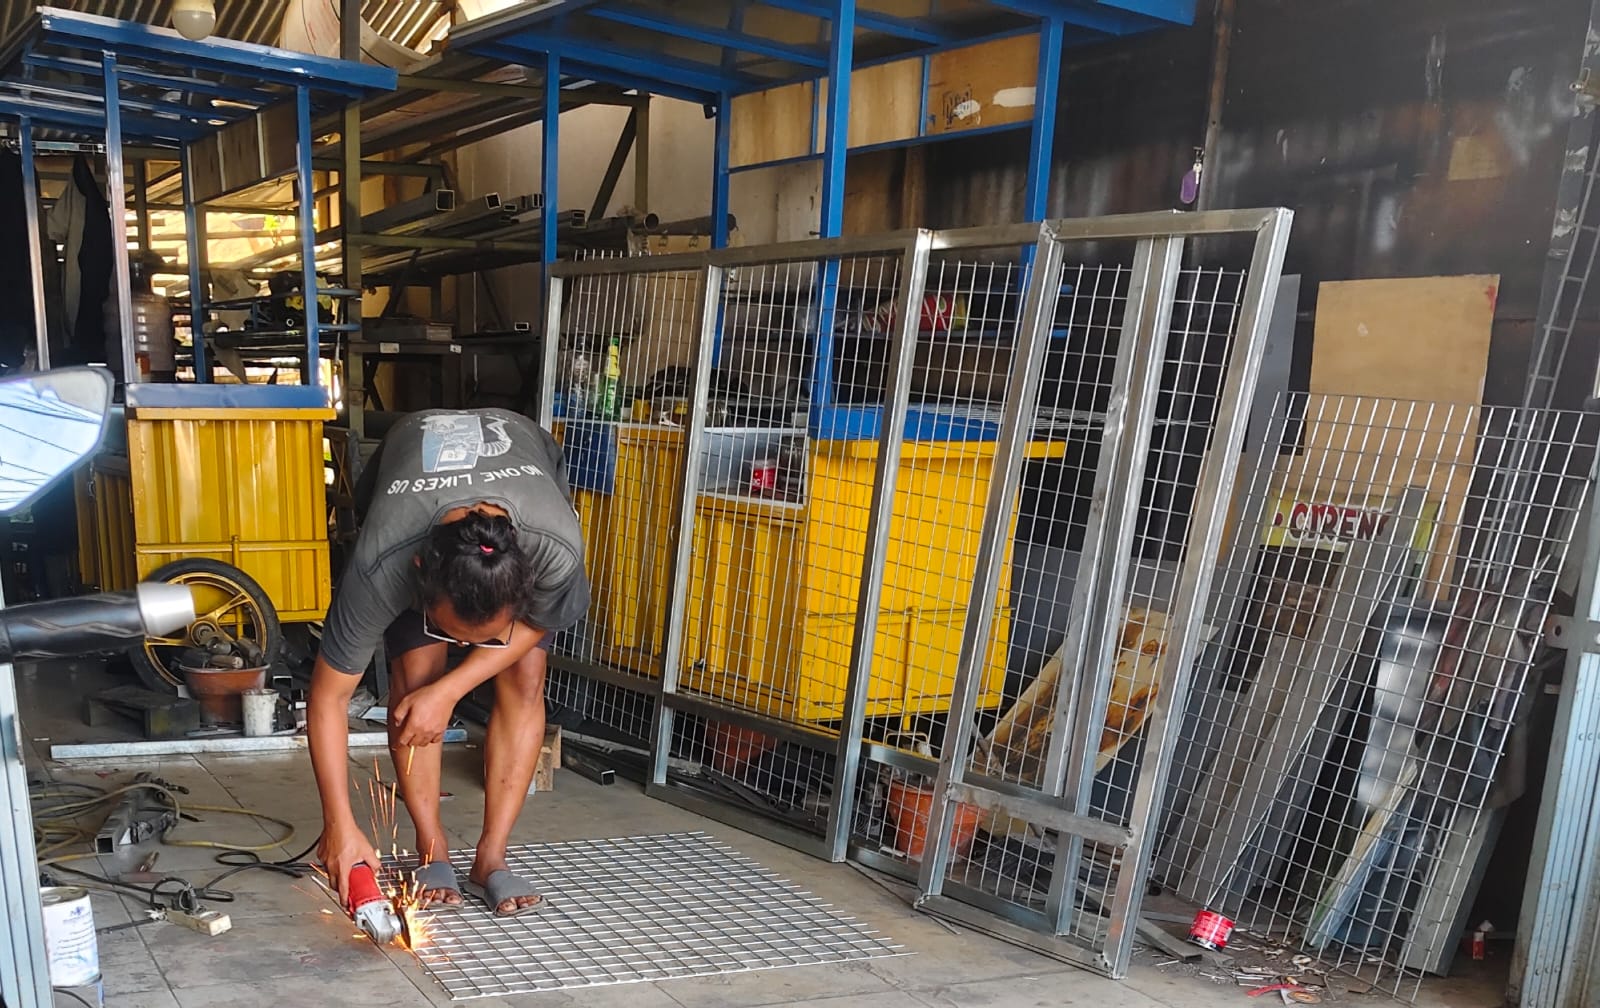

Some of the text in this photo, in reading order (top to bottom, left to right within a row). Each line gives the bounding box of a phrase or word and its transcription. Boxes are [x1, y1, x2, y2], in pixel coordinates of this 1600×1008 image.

[387, 464, 544, 495] NO ONE LIKES US
[1288, 502, 1392, 543] CIREN
